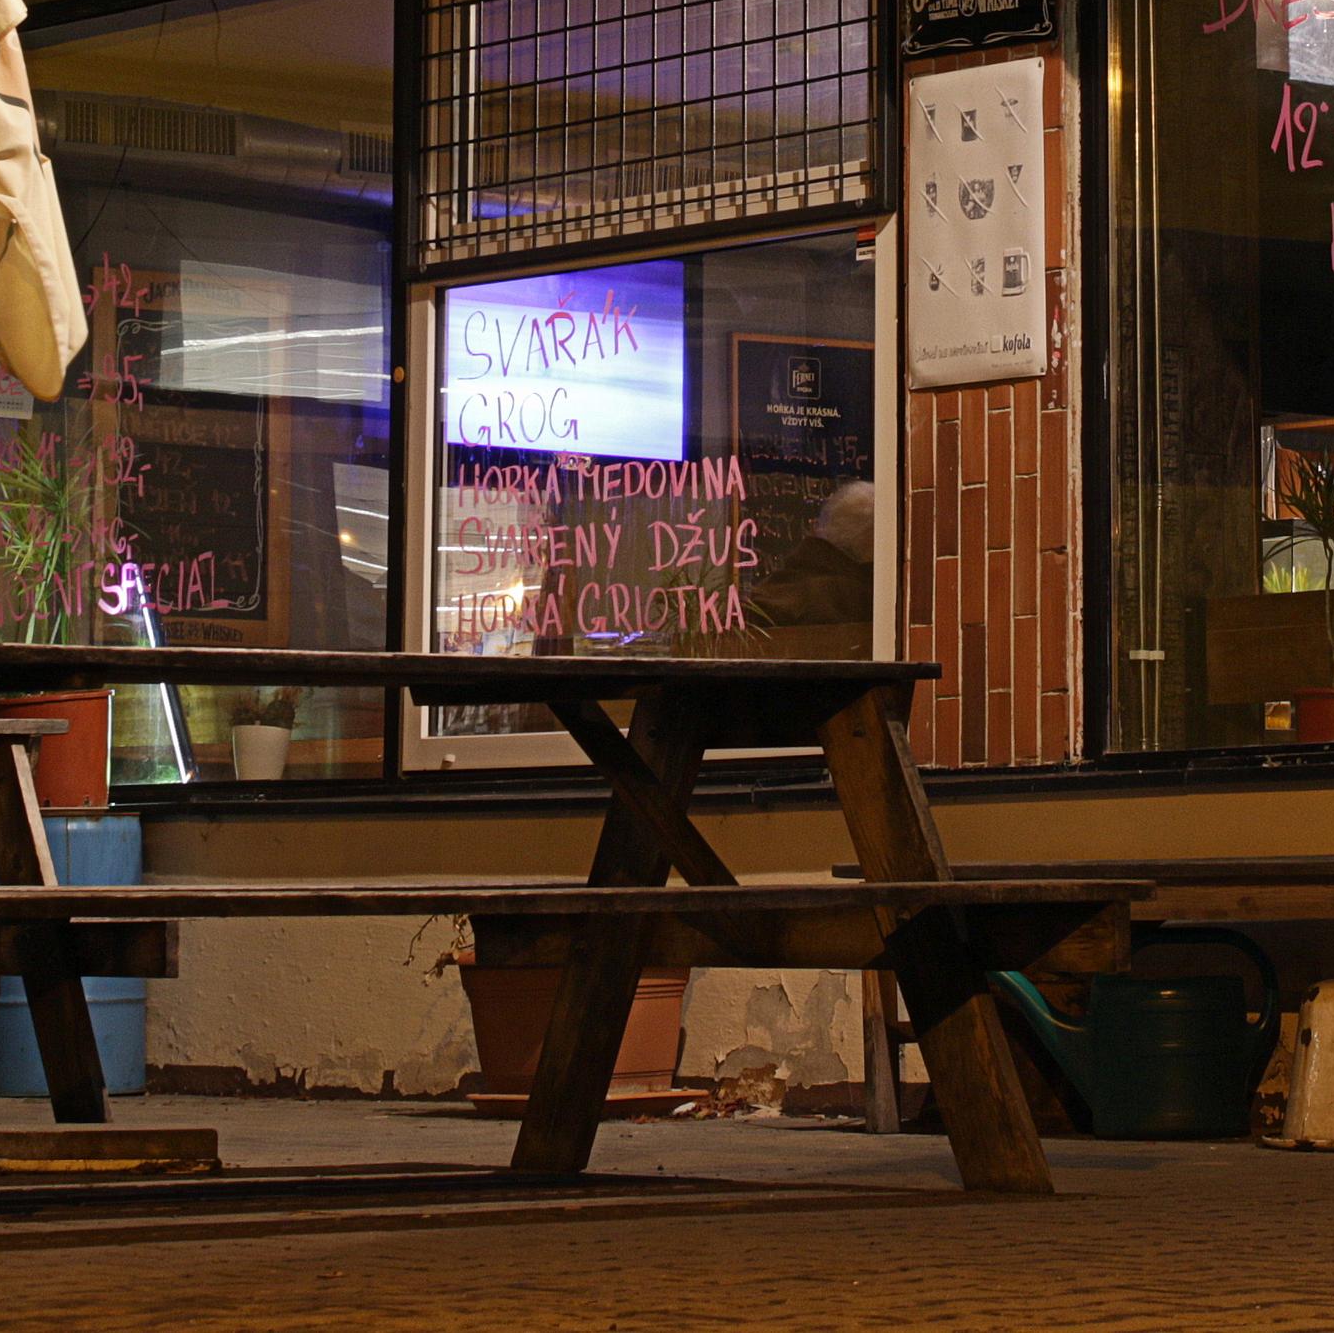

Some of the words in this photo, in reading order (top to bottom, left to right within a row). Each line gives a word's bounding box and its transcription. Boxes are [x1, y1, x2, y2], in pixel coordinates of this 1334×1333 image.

[457, 289, 639, 381] SVAŘÁK
[1002, 333, 1032, 356] kofola
[458, 387, 579, 449] GROG
[578, 455, 747, 503] MEDOVINA
[649, 507, 760, 572] DŽUS
[456, 573, 564, 641] HORKÁ
[578, 582, 747, 635] GRIOTKA
